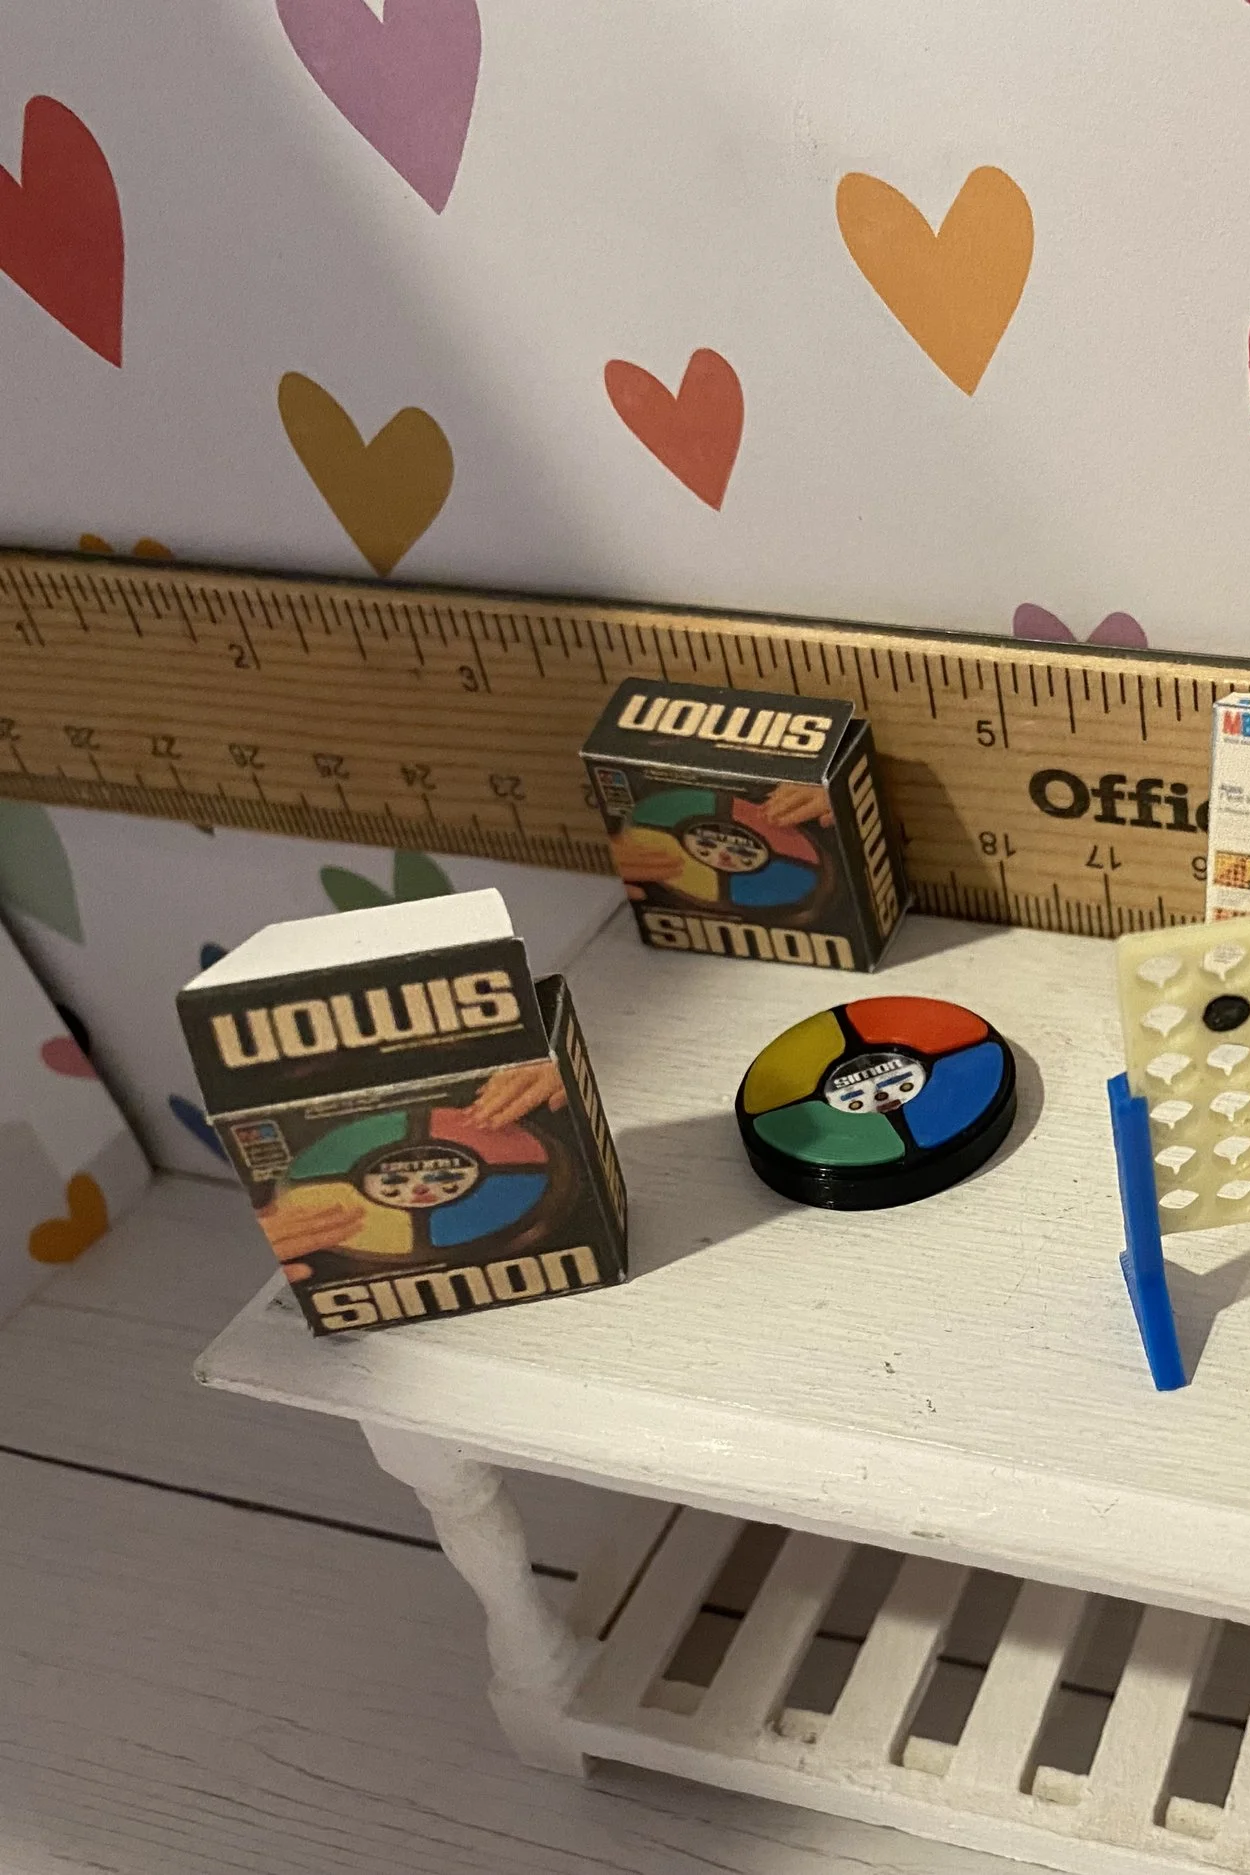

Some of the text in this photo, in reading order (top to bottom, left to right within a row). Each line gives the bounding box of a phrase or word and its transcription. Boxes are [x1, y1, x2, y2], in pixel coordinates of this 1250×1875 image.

[228, 643, 250, 669] 2
[459, 665, 479, 692] 3
[976, 720, 996, 747] 5
[401, 763, 437, 790] 24
[489, 774, 526, 800] 23
[978, 831, 1017, 859] 18
[1085, 844, 1122, 871] 17
